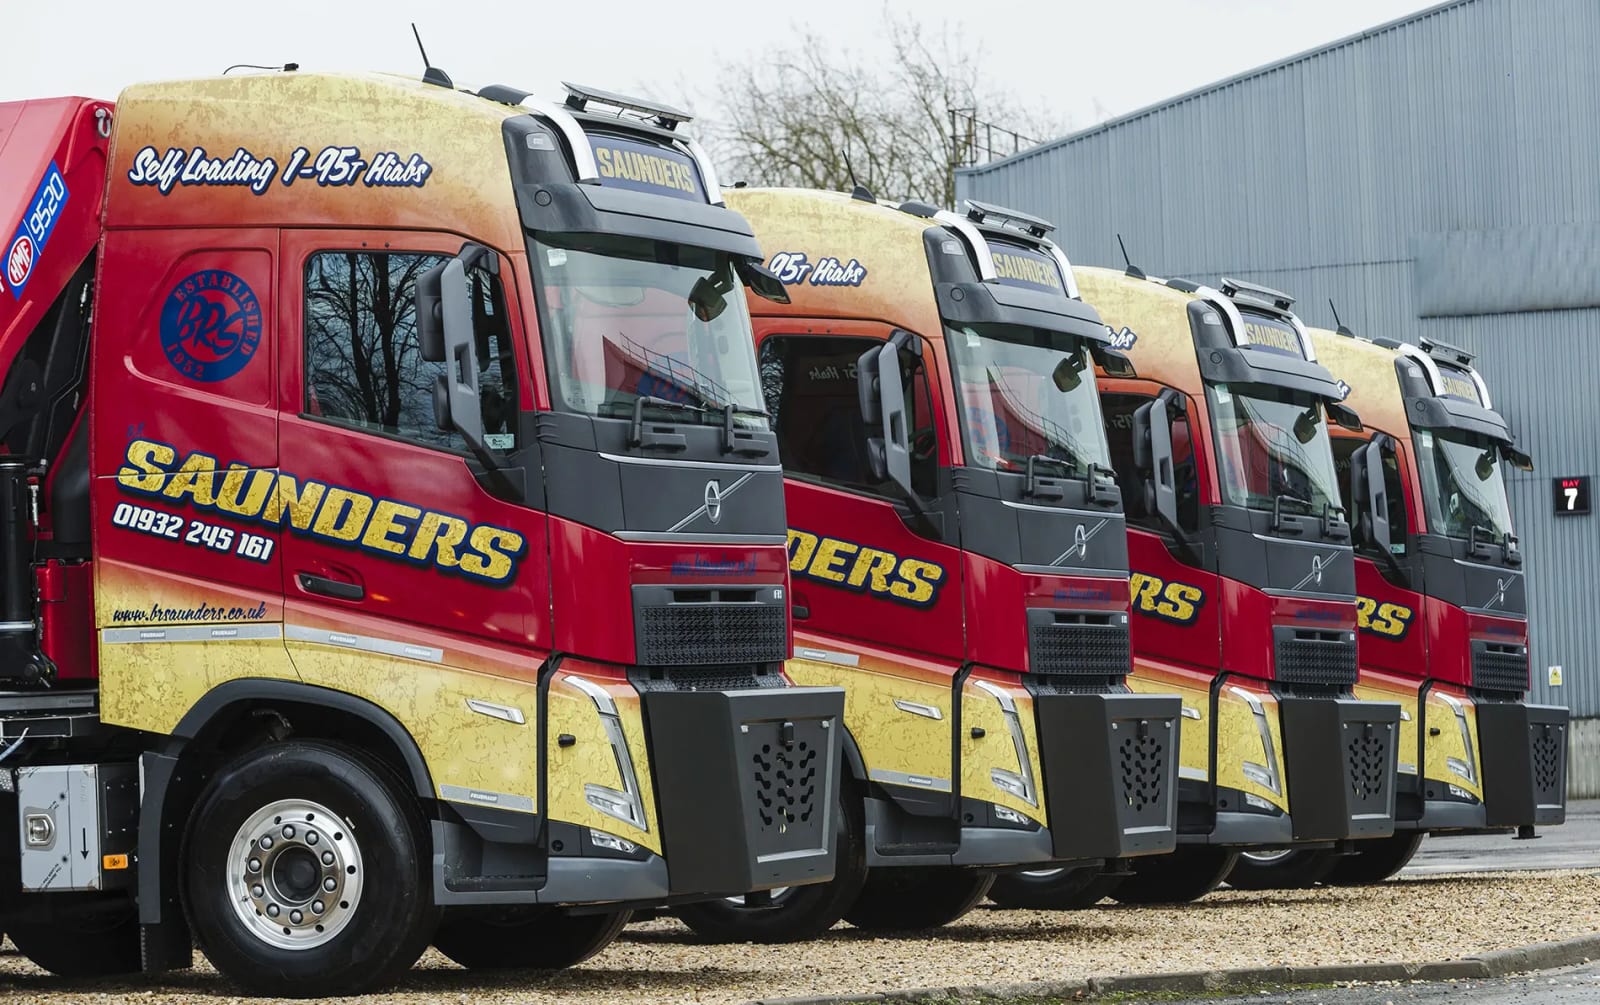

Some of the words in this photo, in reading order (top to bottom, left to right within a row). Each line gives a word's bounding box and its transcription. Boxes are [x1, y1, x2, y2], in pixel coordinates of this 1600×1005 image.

[129, 146, 183, 192] Self
[180, 147, 275, 192] Loading
[364, 152, 429, 185] Hiabs
[595, 147, 695, 194] SAUNDERS
[9, 240, 31, 282] HMF
[30, 172, 65, 242] 9520
[810, 258, 865, 284] Hiabs
[991, 252, 1060, 289] SAUNDERS
[174, 273, 259, 356] ESTABLISHED
[166, 342, 205, 378] 1952
[1562, 479, 1580, 488] BAY
[1564, 487, 1578, 511] 7
[116, 439, 524, 581] SAUNDERS
[112, 502, 185, 539] 01932
[185, 520, 235, 551] 245
[236, 532, 275, 561] 161
[112, 600, 268, 623] www.brsaunders.co.uk
